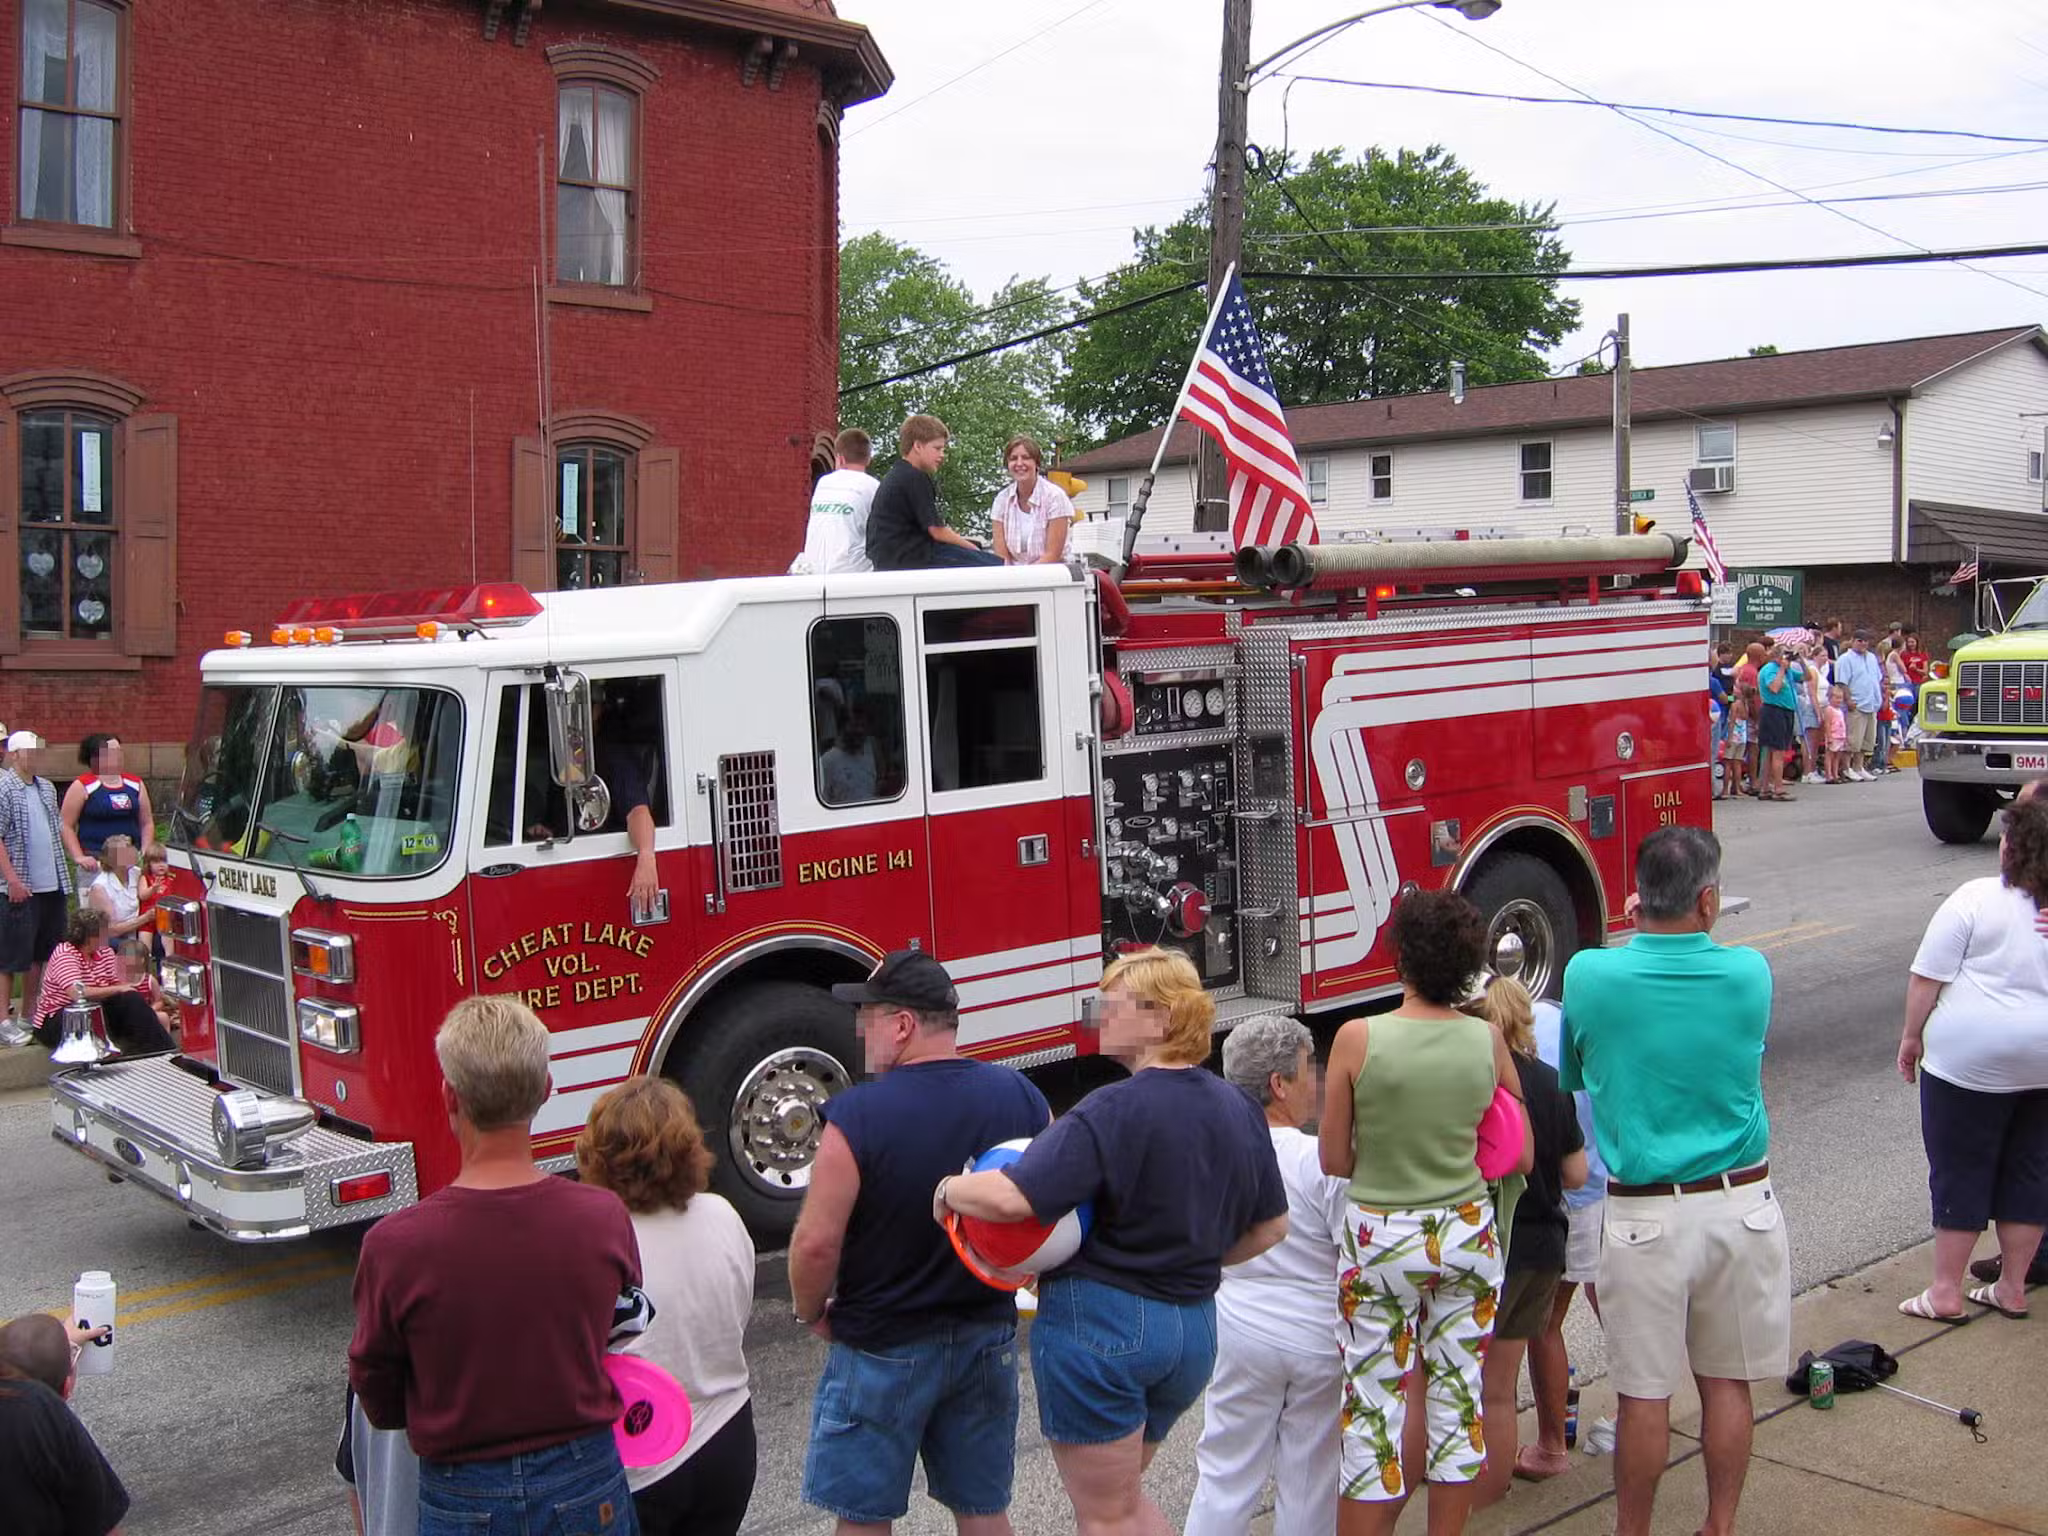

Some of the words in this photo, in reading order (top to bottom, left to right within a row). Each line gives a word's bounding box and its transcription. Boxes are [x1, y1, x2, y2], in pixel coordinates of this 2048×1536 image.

[1737, 573, 1760, 592] FAMILY
[1762, 574, 1794, 596] DENTISTRY
[2003, 686, 2048, 702] GM
[2016, 756, 2048, 769] 9M4
[1653, 790, 1682, 809] DIAL
[1659, 809, 1677, 826] 911
[404, 837, 416, 849] 12
[799, 853, 878, 883] ENGINE
[888, 849, 913, 870] 141
[218, 865, 249, 893] CHEAT
[250, 872, 277, 898] LAKE
[483, 922, 574, 978] CHEAT
[584, 921, 655, 959] LAKE
[545, 952, 600, 977] VOL.
[500, 985, 561, 1009] IRE
[575, 972, 644, 1002] DEPT.
